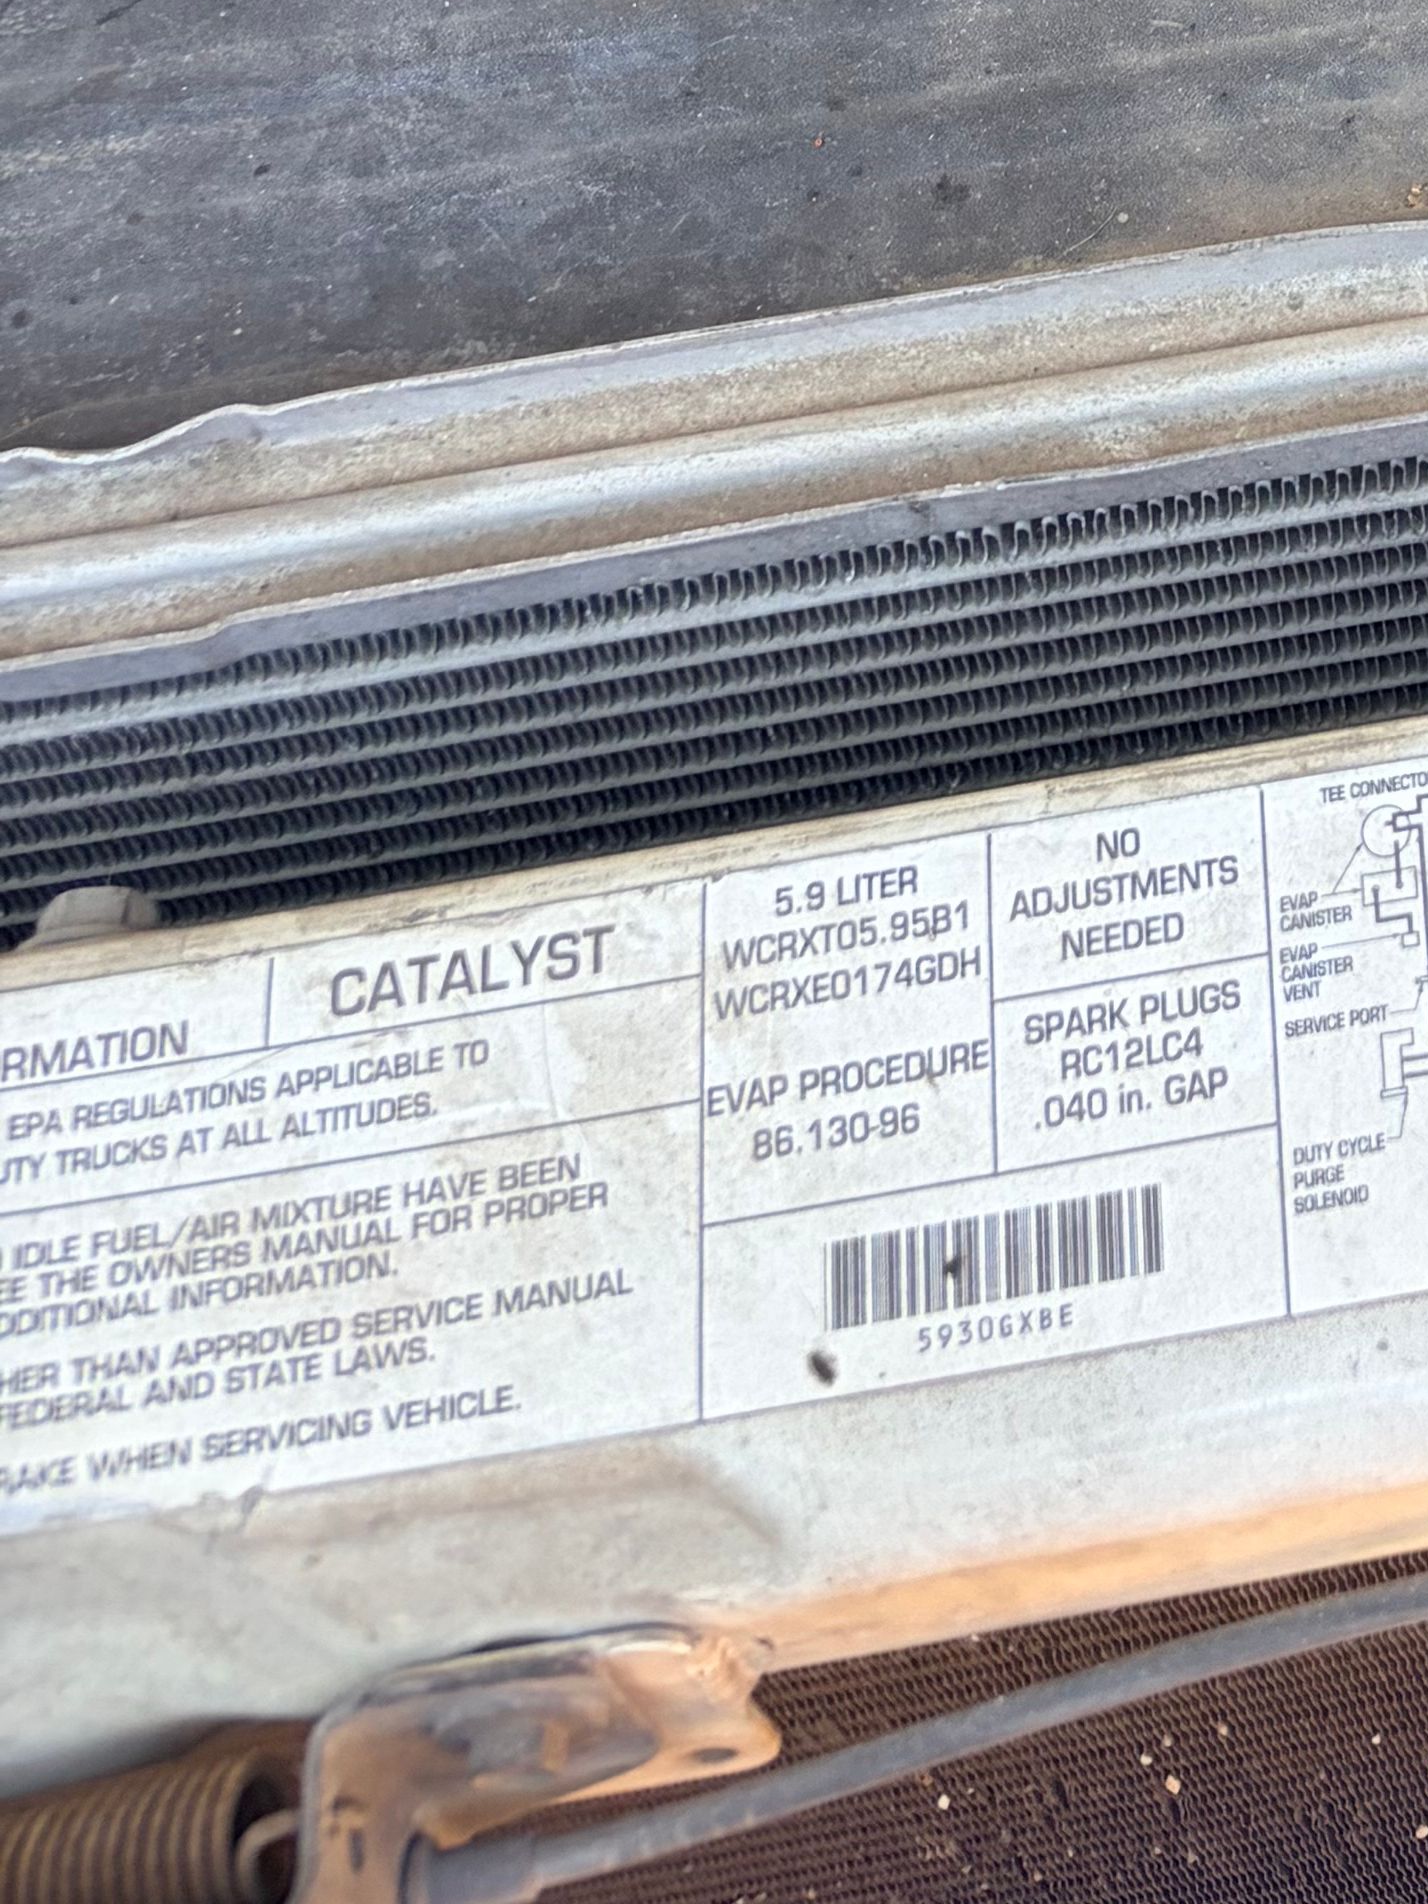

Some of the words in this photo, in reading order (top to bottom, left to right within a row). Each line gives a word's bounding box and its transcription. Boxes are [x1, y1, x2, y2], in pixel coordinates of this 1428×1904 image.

[1096, 827, 1140, 862] NO
[774, 880, 825, 917] 5.9
[836, 865, 918, 906] LITER
[1010, 855, 1238, 920] ADJUSTMENTS
[1060, 912, 1184, 961] NEEDED
[1278, 942, 1318, 964] EVAP
[330, 925, 613, 1016] CATALYST
[1280, 955, 1353, 983] CANISTER
[1282, 980, 1320, 1002] VENT
[1024, 998, 1129, 1045] SPARK
[1139, 979, 1240, 1024] PLUGS
[1284, 1011, 1345, 1038] SERVICE
[1348, 1003, 1387, 1027] PORT
[0, 1020, 188, 1081] RMATION
[702, 1074, 788, 1117] EVAP
[799, 1038, 988, 1100] PROCEDURE
[1060, 1026, 1202, 1080] RC12LC4
[6, 1108, 63, 1141] EPA
[71, 1076, 266, 1130] REGULATIONS
[274, 1046, 443, 1098] APPLICABLE
[452, 1038, 489, 1069] TO
[1034, 1087, 1107, 1129] .040
[1118, 1082, 1151, 1114] in.
[1163, 1066, 1228, 1106] GAP
[55, 1133, 167, 1174] TRUCKS
[174, 1126, 214, 1160] AT
[220, 1117, 272, 1150] ALL
[280, 1091, 437, 1140] ALTITUDES.
[751, 1102, 919, 1161] 86.130-96
[12, 1234, 80, 1269] IDLE
[90, 1210, 240, 1257] FUEL/AIR
[250, 1184, 391, 1232] MIXTURE
[401, 1168, 486, 1208] HAVE
[496, 1152, 580, 1192] BEEN
[168, 1251, 397, 1311] INFORMATION.
[71, 1345, 160, 1381] THAN
[170, 1317, 341, 1366] APPROVED
[351, 1292, 482, 1338] SERVICE
[492, 1268, 632, 1316] MANUAL
[141, 1370, 215, 1407] AND
[224, 1352, 321, 1394] STATE
[333, 1335, 435, 1377] LAWS.
[88, 1439, 192, 1480] WHEN
[201, 1408, 372, 1461] SERVICING
[382, 1384, 520, 1431] VEHICLE.
